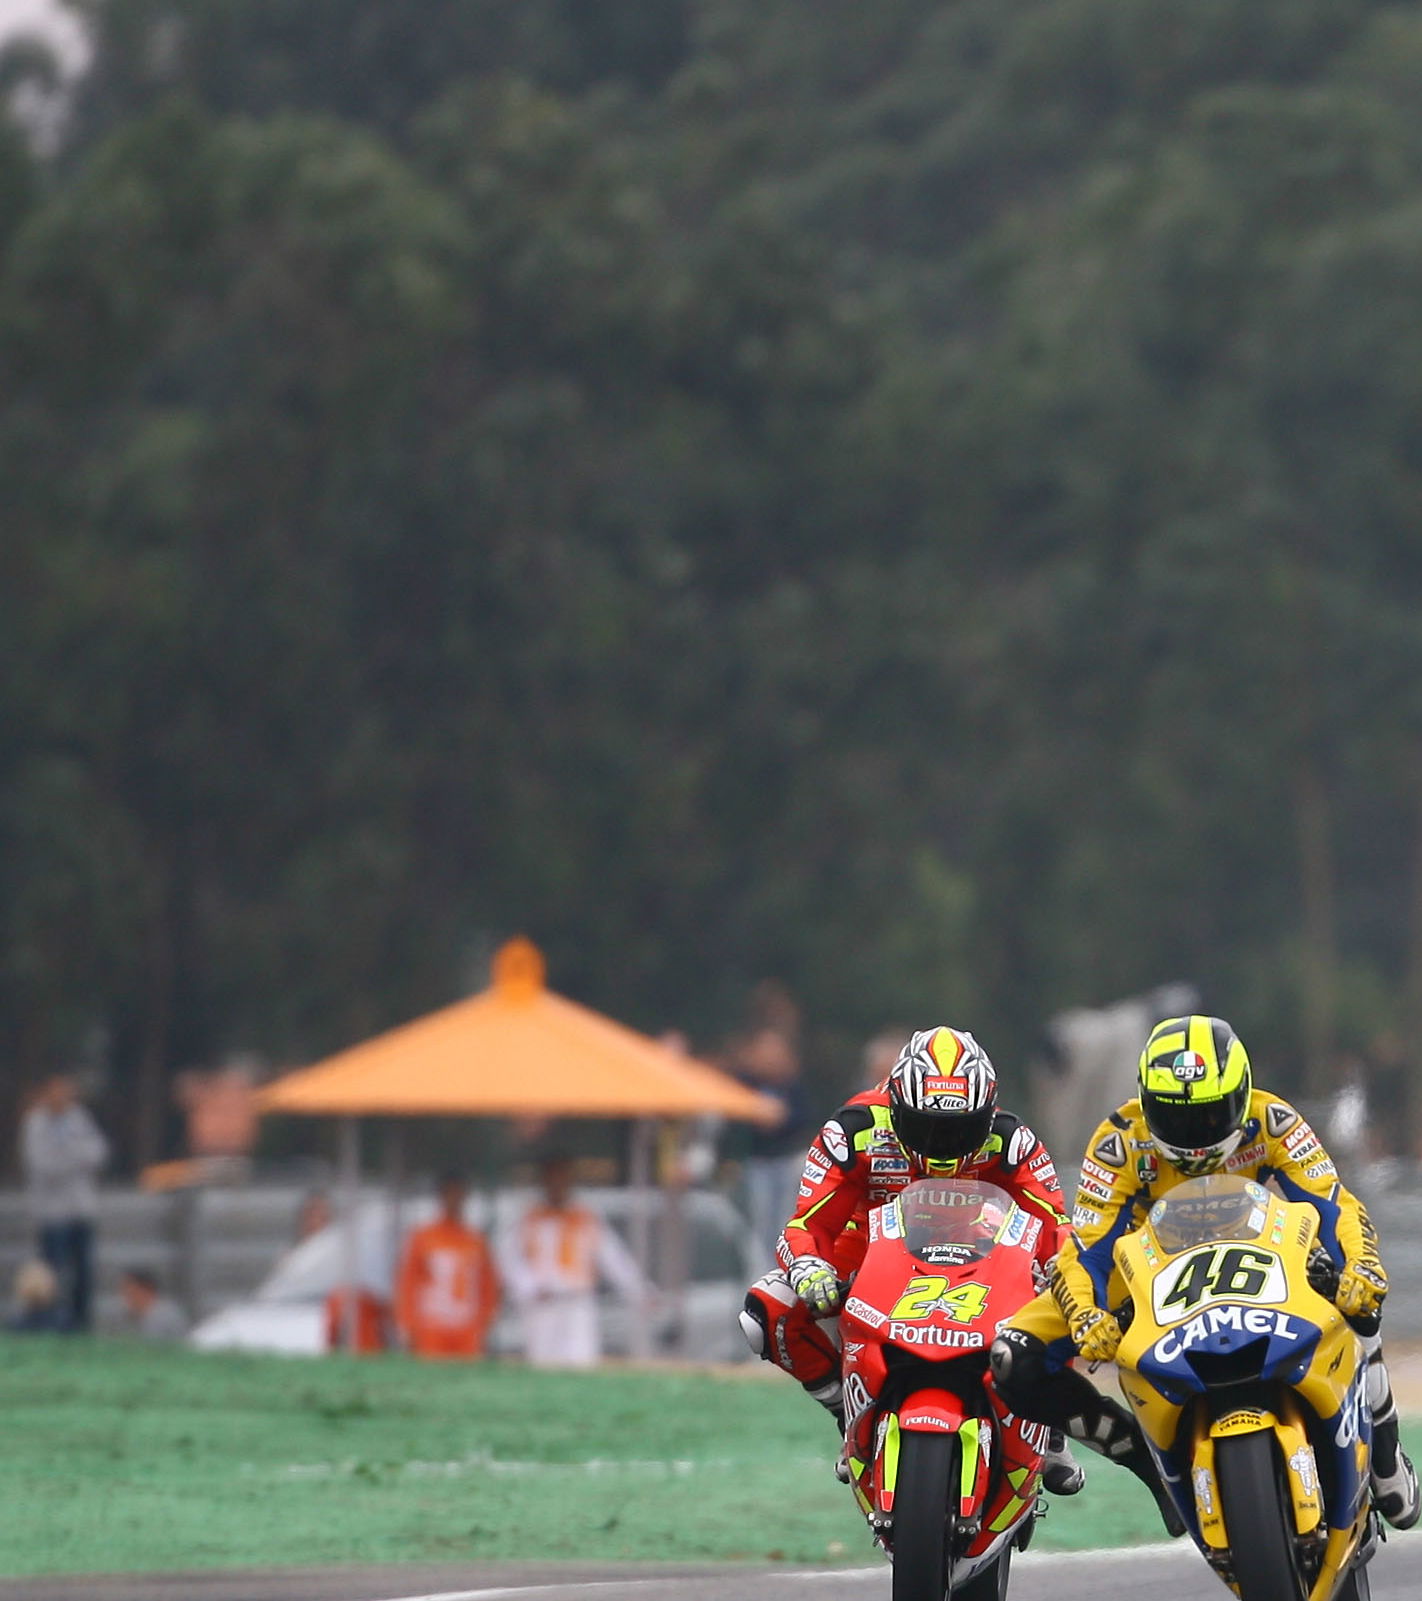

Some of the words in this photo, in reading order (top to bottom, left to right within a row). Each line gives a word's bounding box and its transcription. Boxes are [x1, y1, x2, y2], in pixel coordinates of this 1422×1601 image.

[1175, 1066, 1204, 1079] agv
[927, 1081, 965, 1090] Fortuna
[927, 1096, 966, 1109] X-lite
[868, 1187, 984, 1208] Fortuna
[921, 1245, 972, 1257] HONDA
[1159, 1246, 1275, 1311] 46
[888, 1275, 991, 1325] 24
[853, 1302, 883, 1326] Castrol
[888, 1322, 984, 1348] Fortuna
[1154, 1305, 1299, 1363] CAMEL
[905, 1415, 951, 1430] Fortuna
